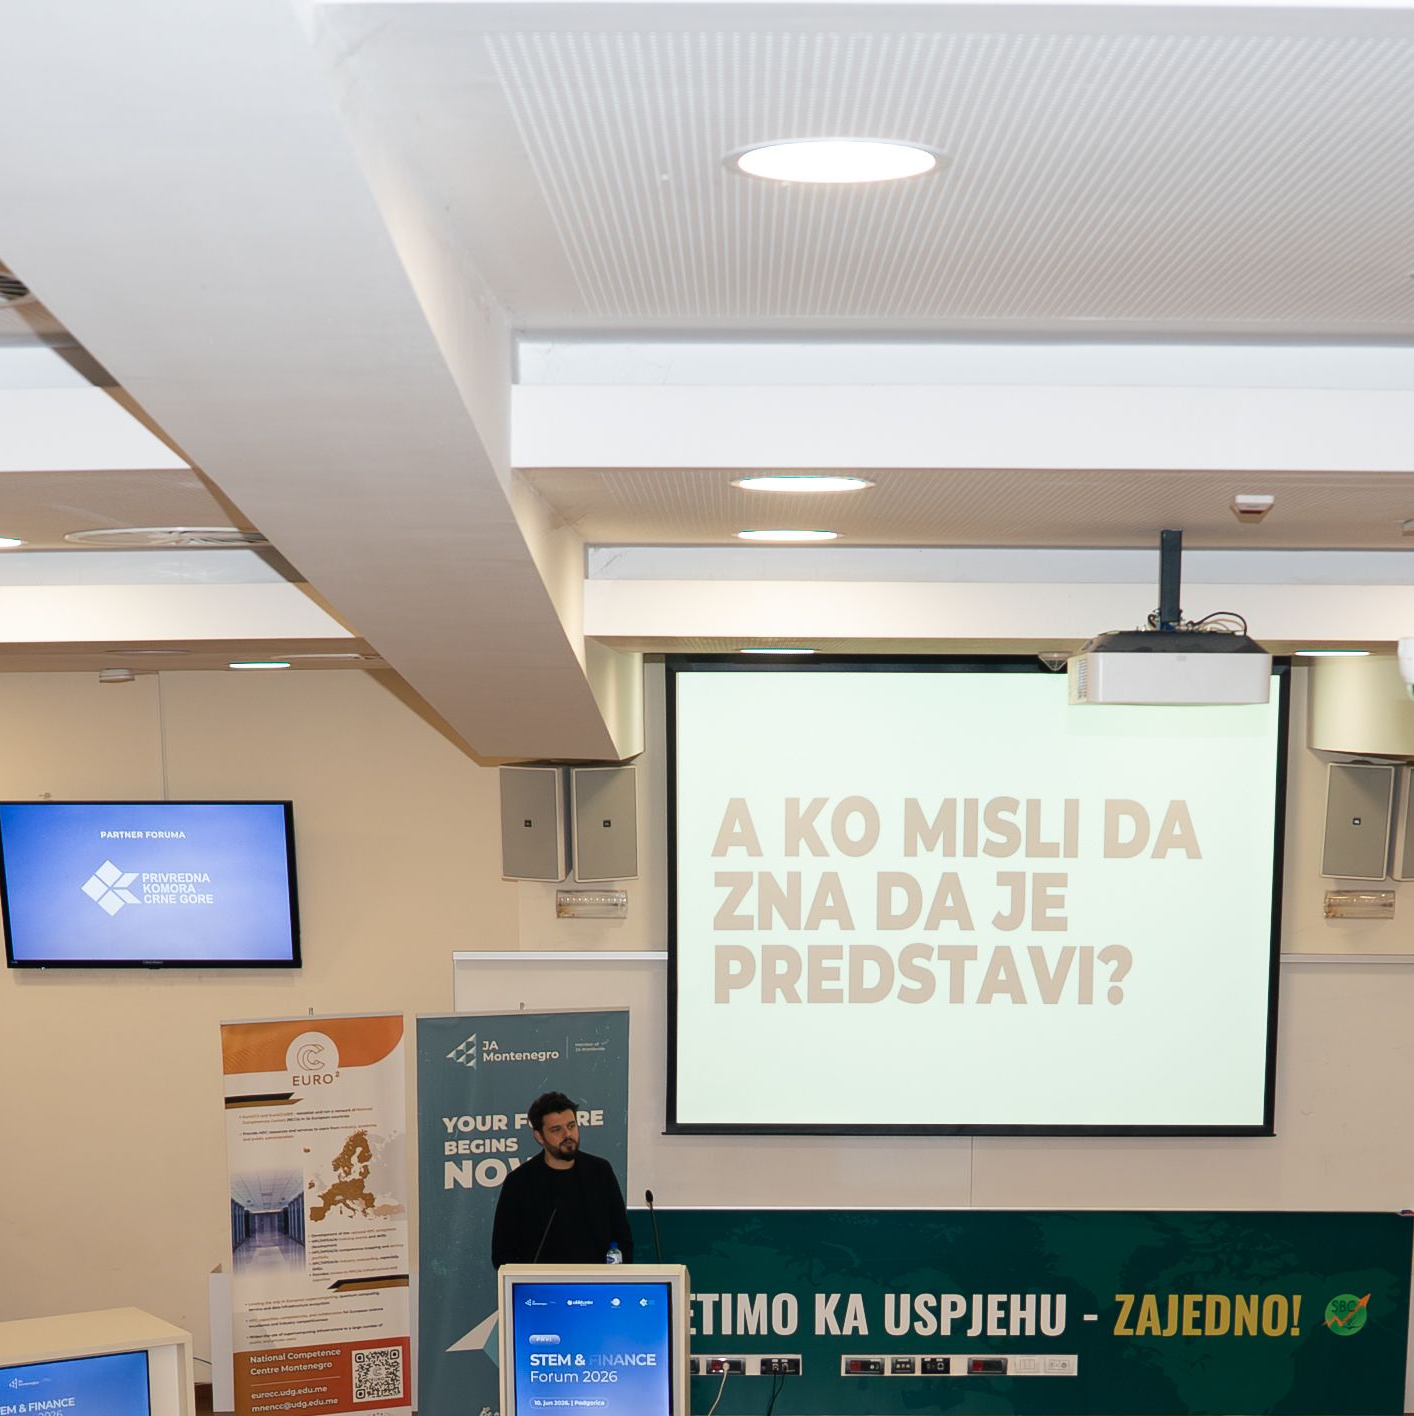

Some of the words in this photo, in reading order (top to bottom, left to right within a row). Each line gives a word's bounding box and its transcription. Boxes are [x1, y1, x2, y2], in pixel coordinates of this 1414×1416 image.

[100, 831, 143, 839] PARTNER
[145, 831, 186, 839] FORUMA
[711, 797, 762, 857] A
[784, 796, 880, 858] KO
[903, 796, 1080, 859] MISLI
[1103, 799, 1202, 860] DA
[142, 872, 211, 883] PRIVREDNA
[143, 884, 196, 894] KOMORA
[144, 894, 177, 904] CRNE
[179, 894, 214, 904] GORE
[713, 871, 855, 931] ZNA
[876, 871, 974, 931] DA
[991, 872, 1068, 932] JE
[714, 942, 1133, 1005] PREDSTAVI?
[483, 1041, 499, 1050] JA
[483, 1050, 559, 1062] Montenegro
[443, 1113, 508, 1134] YOUR
[515, 1110, 604, 1130] FRE
[444, 1138, 519, 1156] BEGINS
[1331, 1300, 1355, 1312] SBC
[815, 1293, 869, 1336] KA
[884, 1293, 1067, 1338] USPJEHU
[1114, 1294, 1302, 1338] ZAJEDNO!
[250, 1352, 286, 1364] National
[287, 1348, 341, 1362] Competence
[530, 1354, 571, 1366] STEM
[575, 1354, 585, 1366] &
[589, 1354, 657, 1366] FINANCE
[251, 1367, 279, 1376] Centre
[281, 1361, 333, 1372] Montenegro
[530, 1371, 579, 1382] Forum
[583, 1371, 618, 1383] 2026
[251, 1386, 327, 1400] eurocc.udg.edu.me
[19, 1404, 27, 1413] &
[29, 1397, 75, 1412] FINANCE
[251, 1398, 339, 1412] mnencc@udg.edu.me
